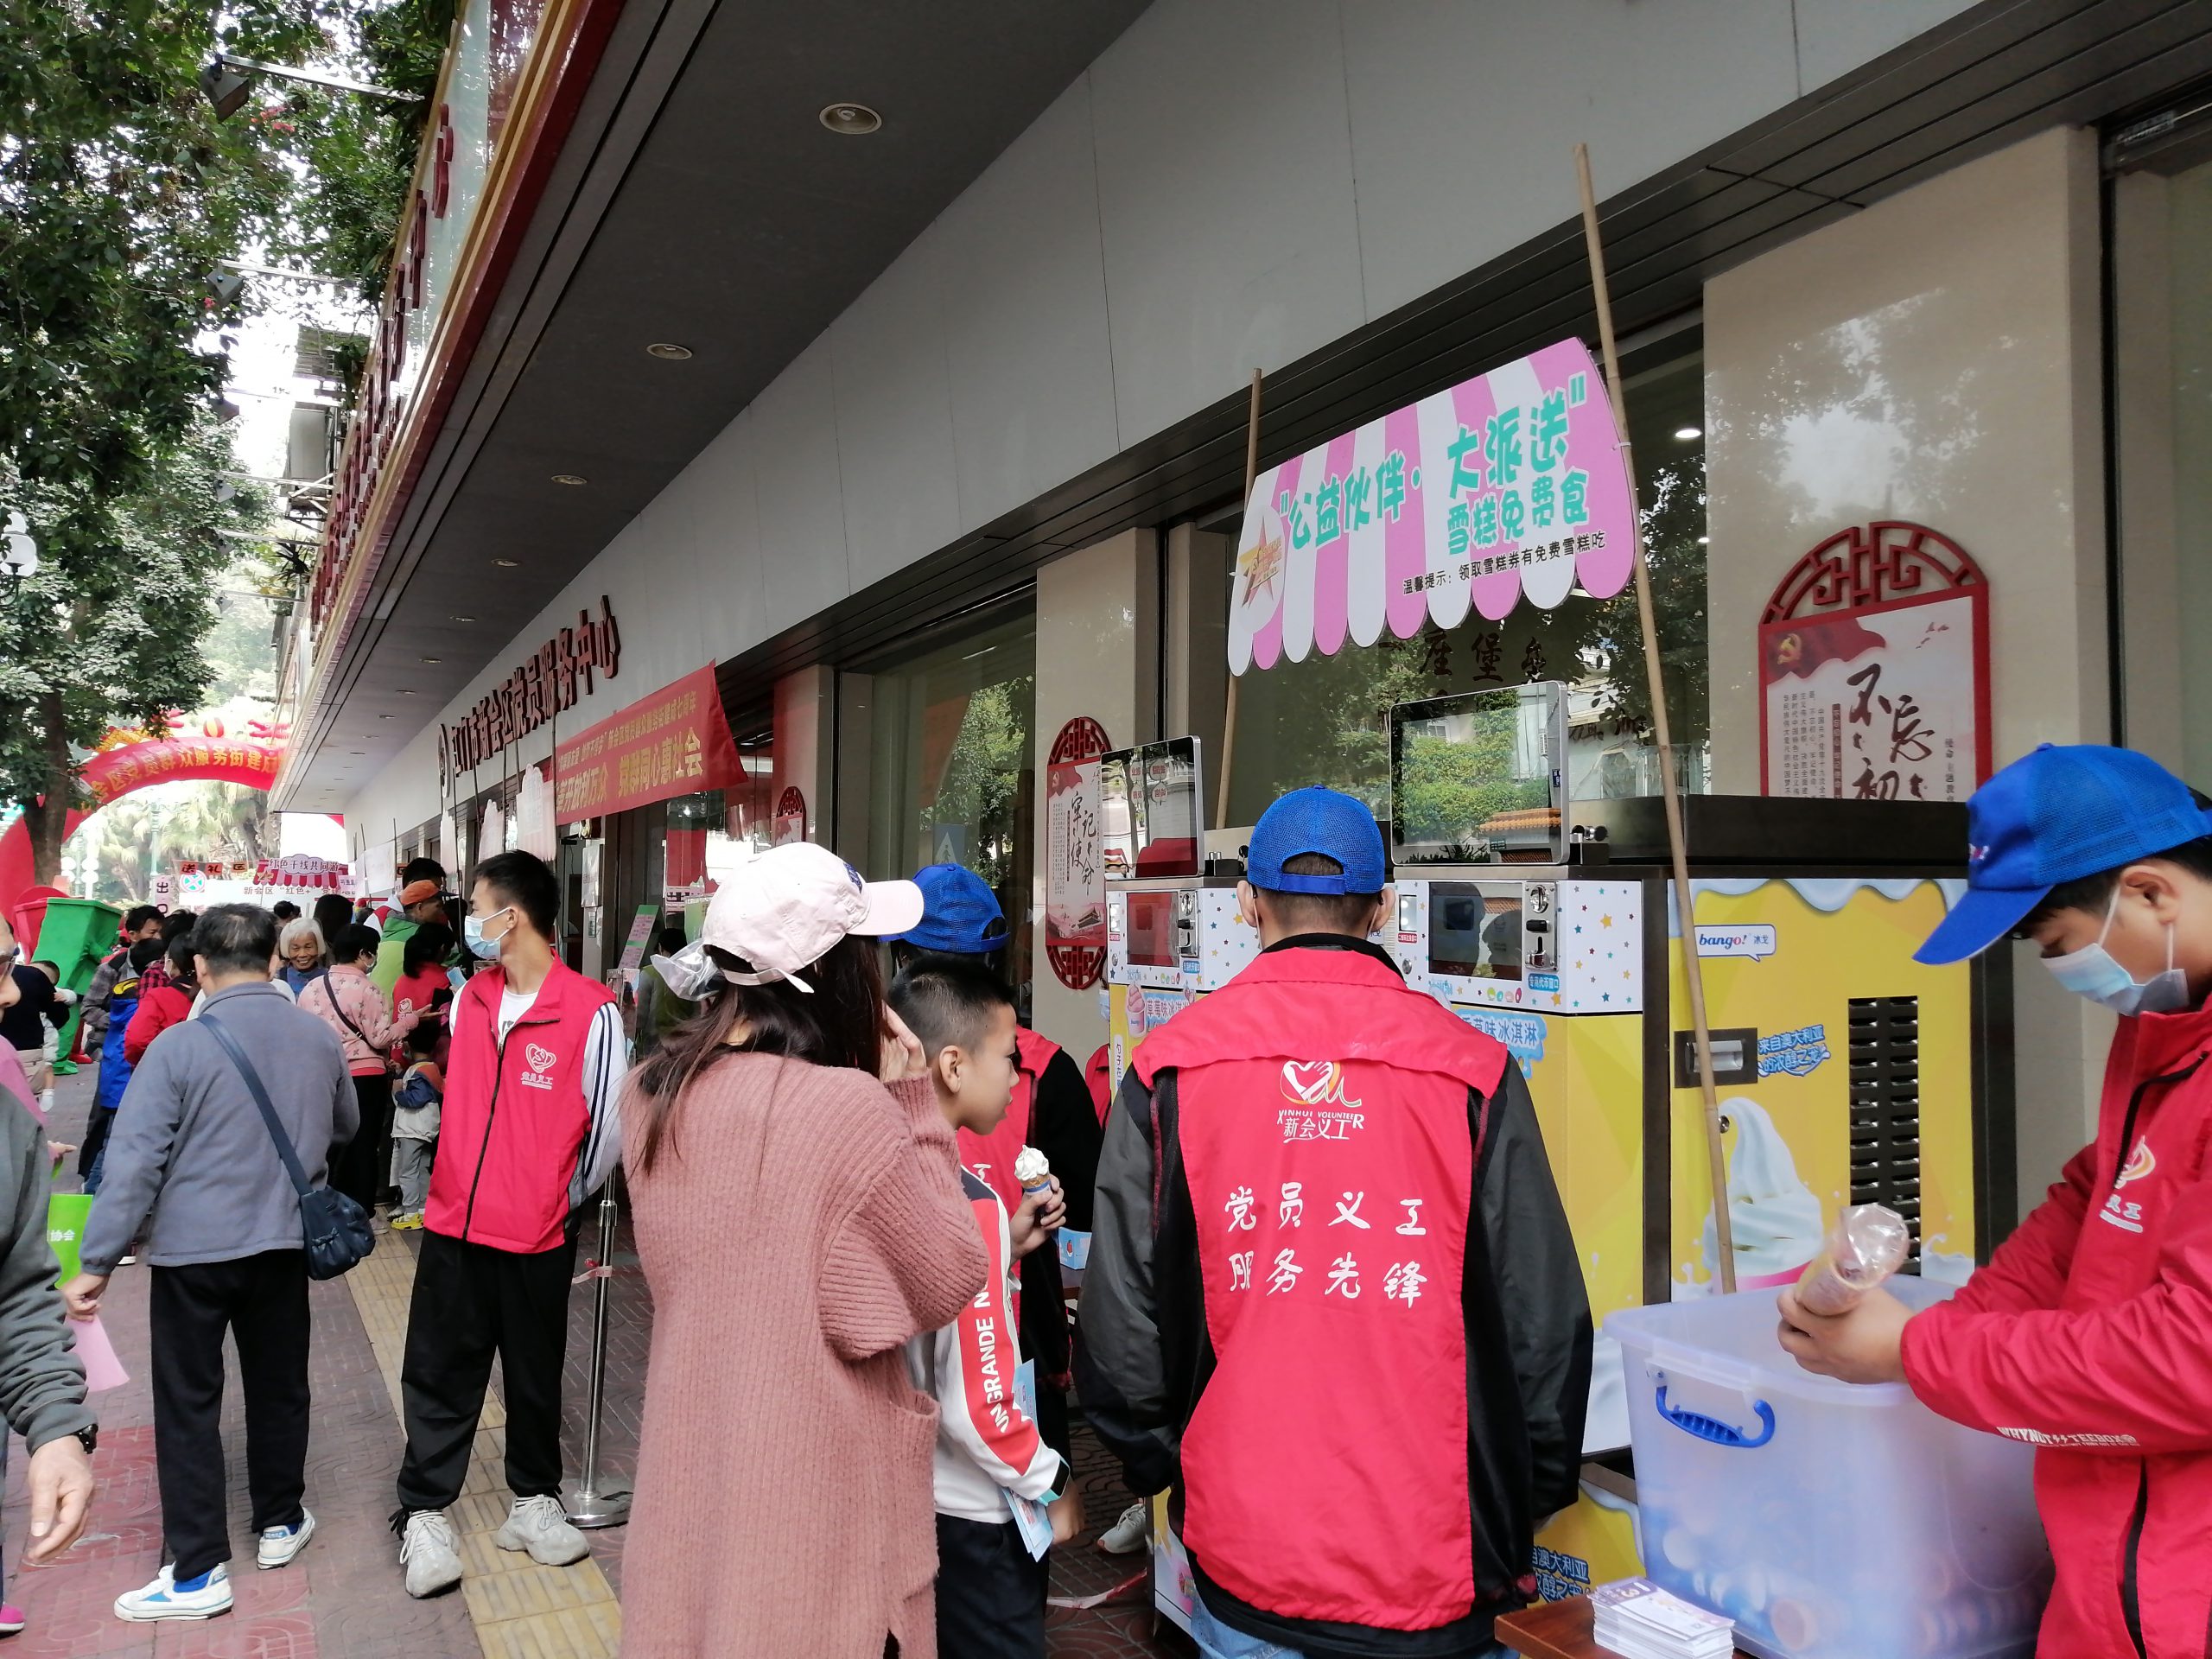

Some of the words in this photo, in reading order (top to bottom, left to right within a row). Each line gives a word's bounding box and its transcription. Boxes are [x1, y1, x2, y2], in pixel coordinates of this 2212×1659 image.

[1446, 470, 1590, 556] 雪糕免费食
[451, 594, 621, 778] 江门市新会区党员服务中心
[1699, 934, 1746, 950] bango!
[1462, 1017, 1538, 1046] 草味冰淇淋
[1277, 1109, 1313, 1125] XINHUI
[1318, 1110, 1365, 1129] VOLUNTEER
[1282, 1118, 1351, 1142] 新会义工
[1224, 1182, 1427, 1236] 党员义工
[973, 1283, 991, 1309] N
[1229, 1248, 1428, 1309] 服务先锋
[976, 1316, 1004, 1404] GRANDE
